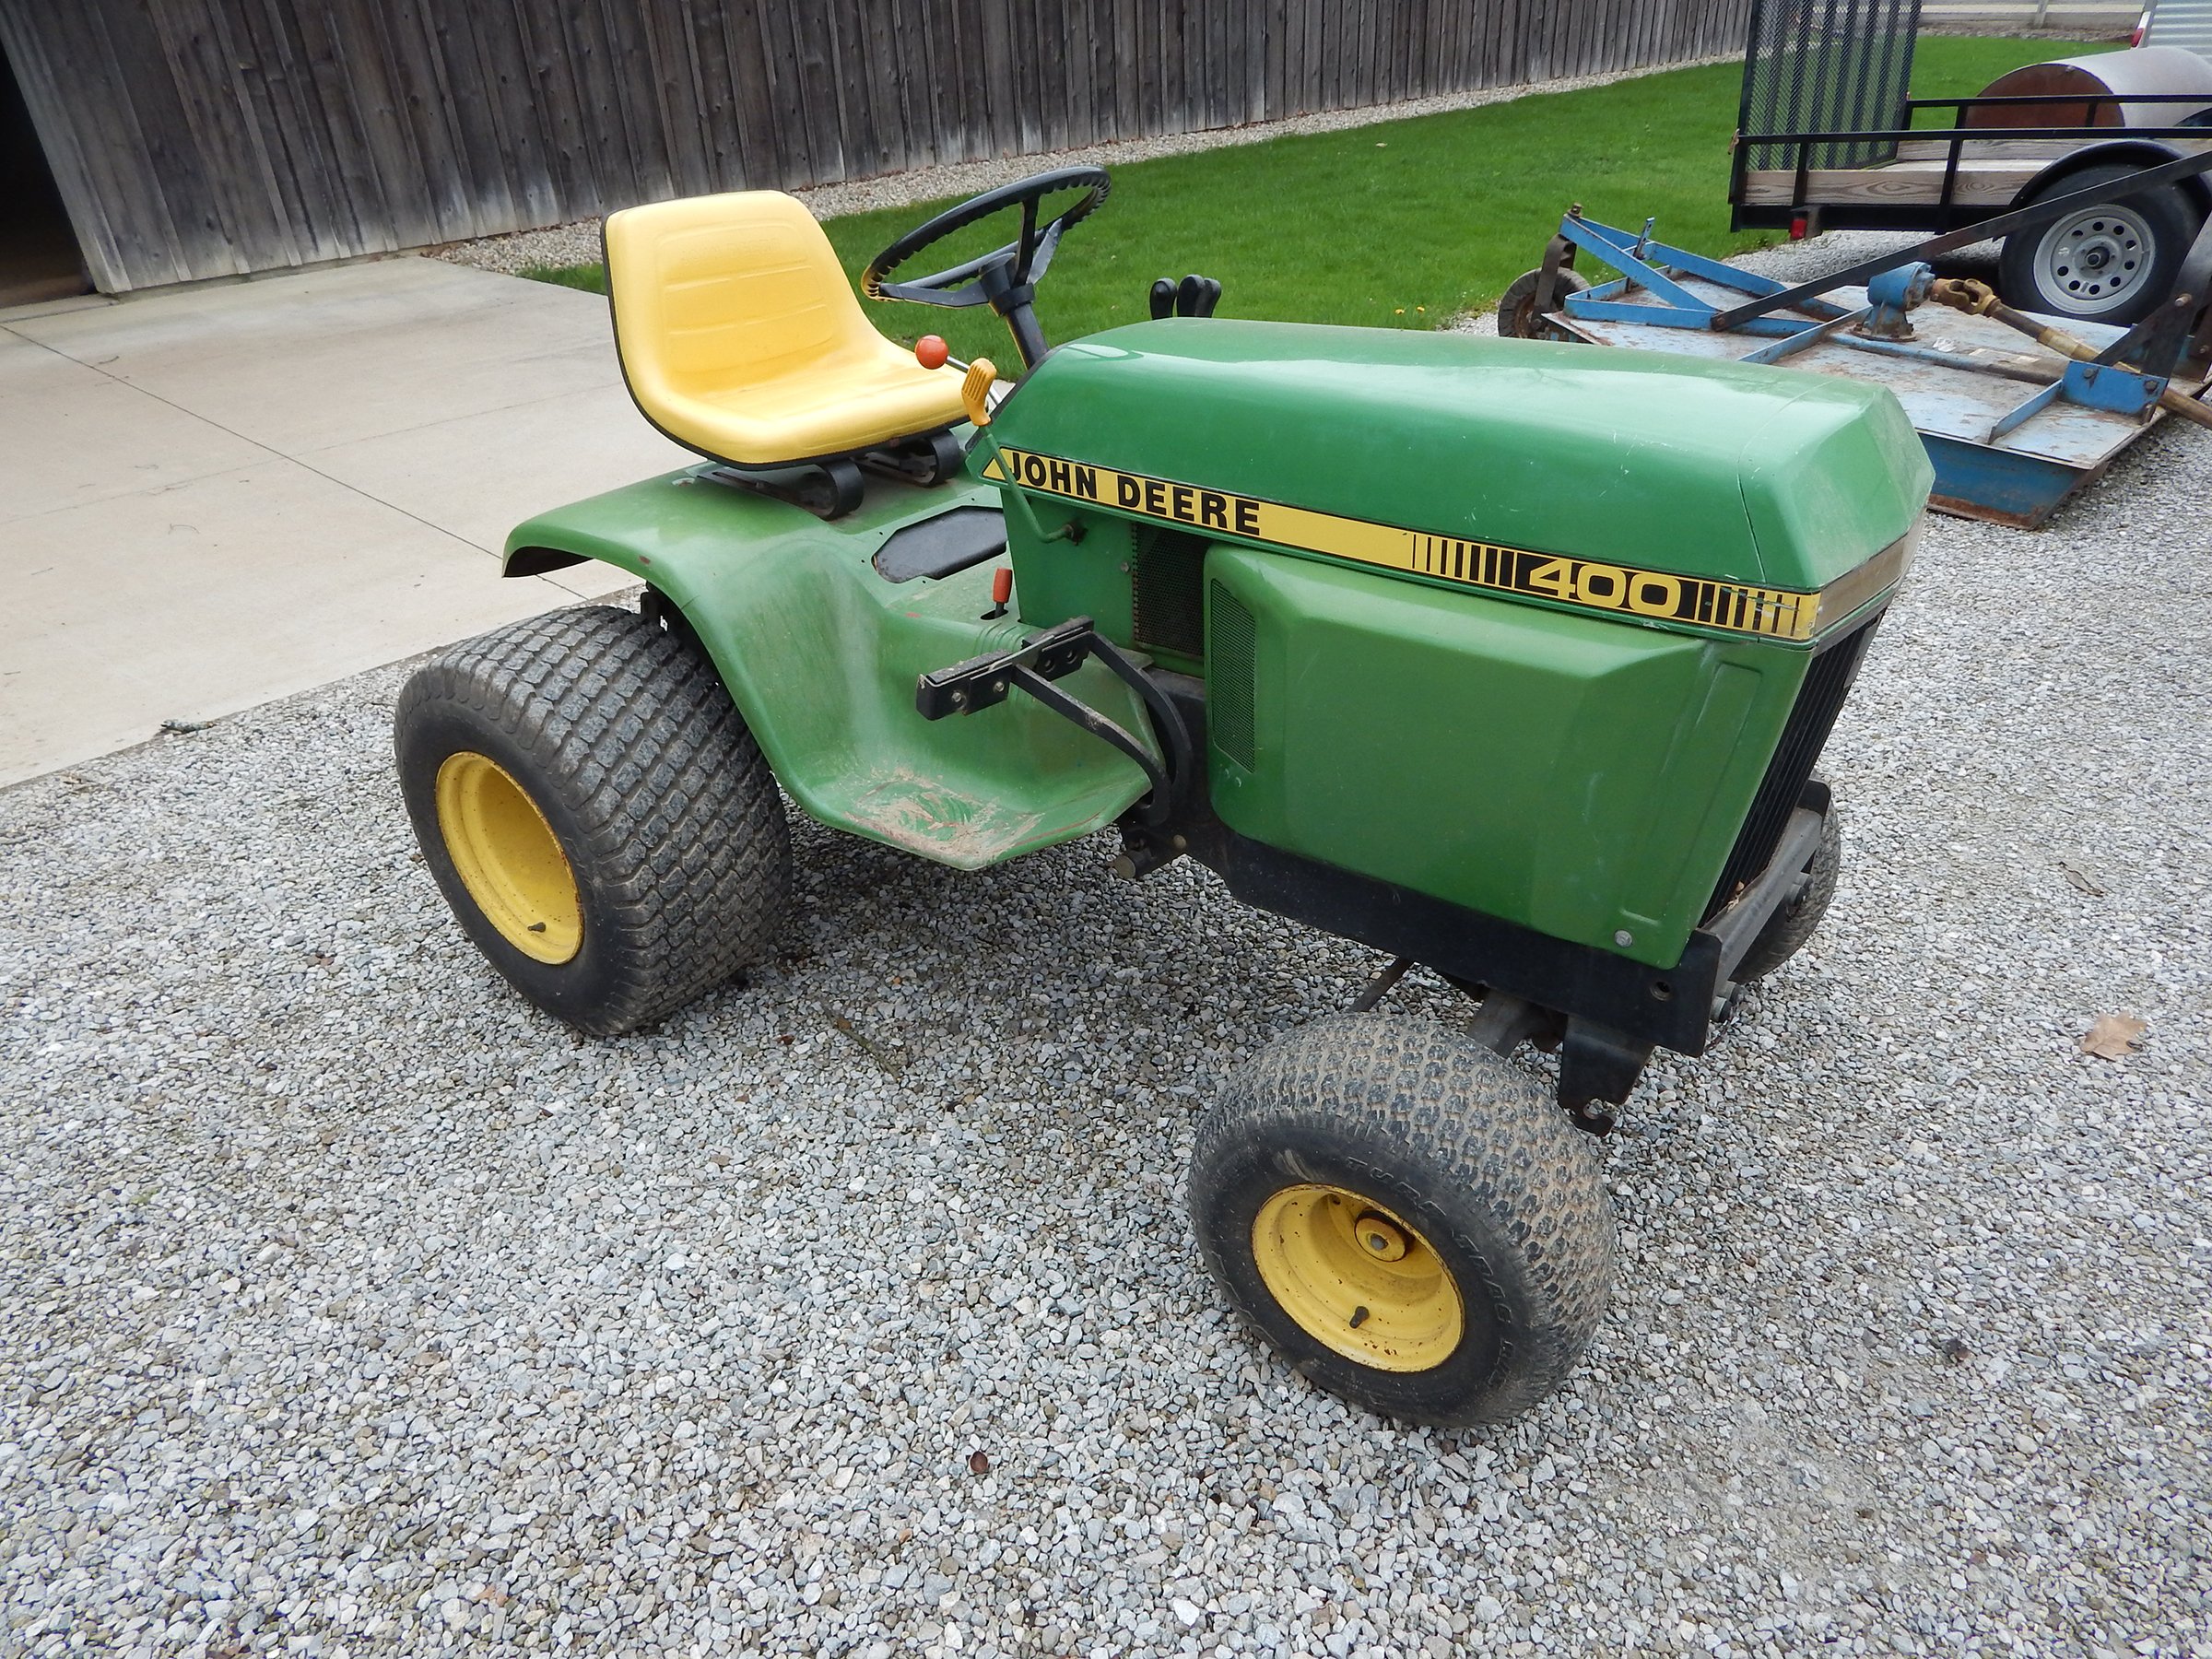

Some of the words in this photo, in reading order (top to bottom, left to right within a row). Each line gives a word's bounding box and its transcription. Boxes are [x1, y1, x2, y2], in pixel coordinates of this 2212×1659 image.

[1009, 452, 1098, 499] JOHN
[1116, 474, 1260, 535] DEERE
[1529, 559, 1681, 618] 400
